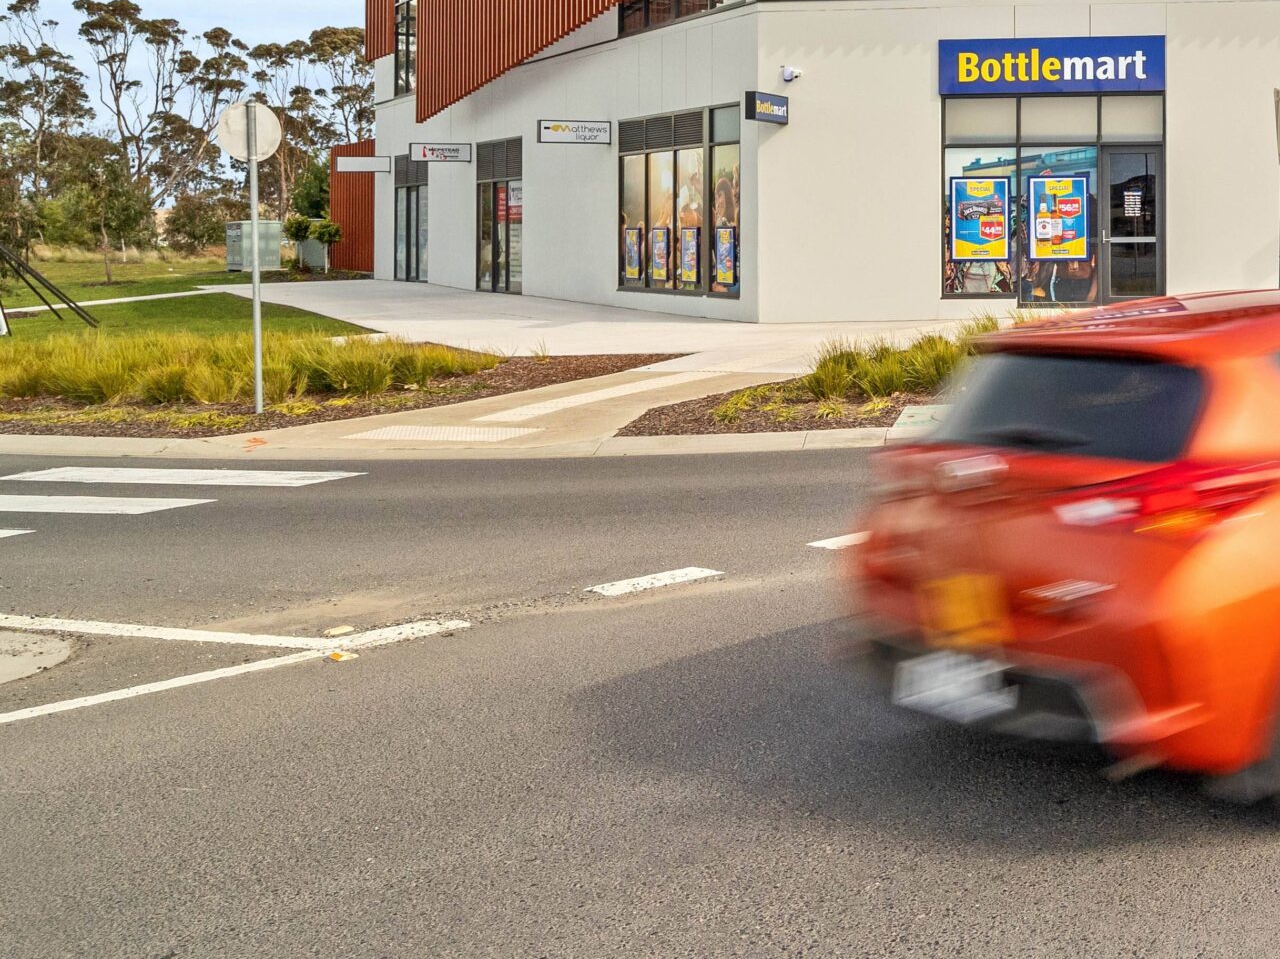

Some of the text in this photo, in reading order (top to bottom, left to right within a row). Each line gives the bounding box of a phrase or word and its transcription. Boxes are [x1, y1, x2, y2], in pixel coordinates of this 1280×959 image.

[957, 48, 1147, 83] Bottlemart
[756, 100, 787, 116] Bottlemart
[575, 132, 599, 141] liquor
